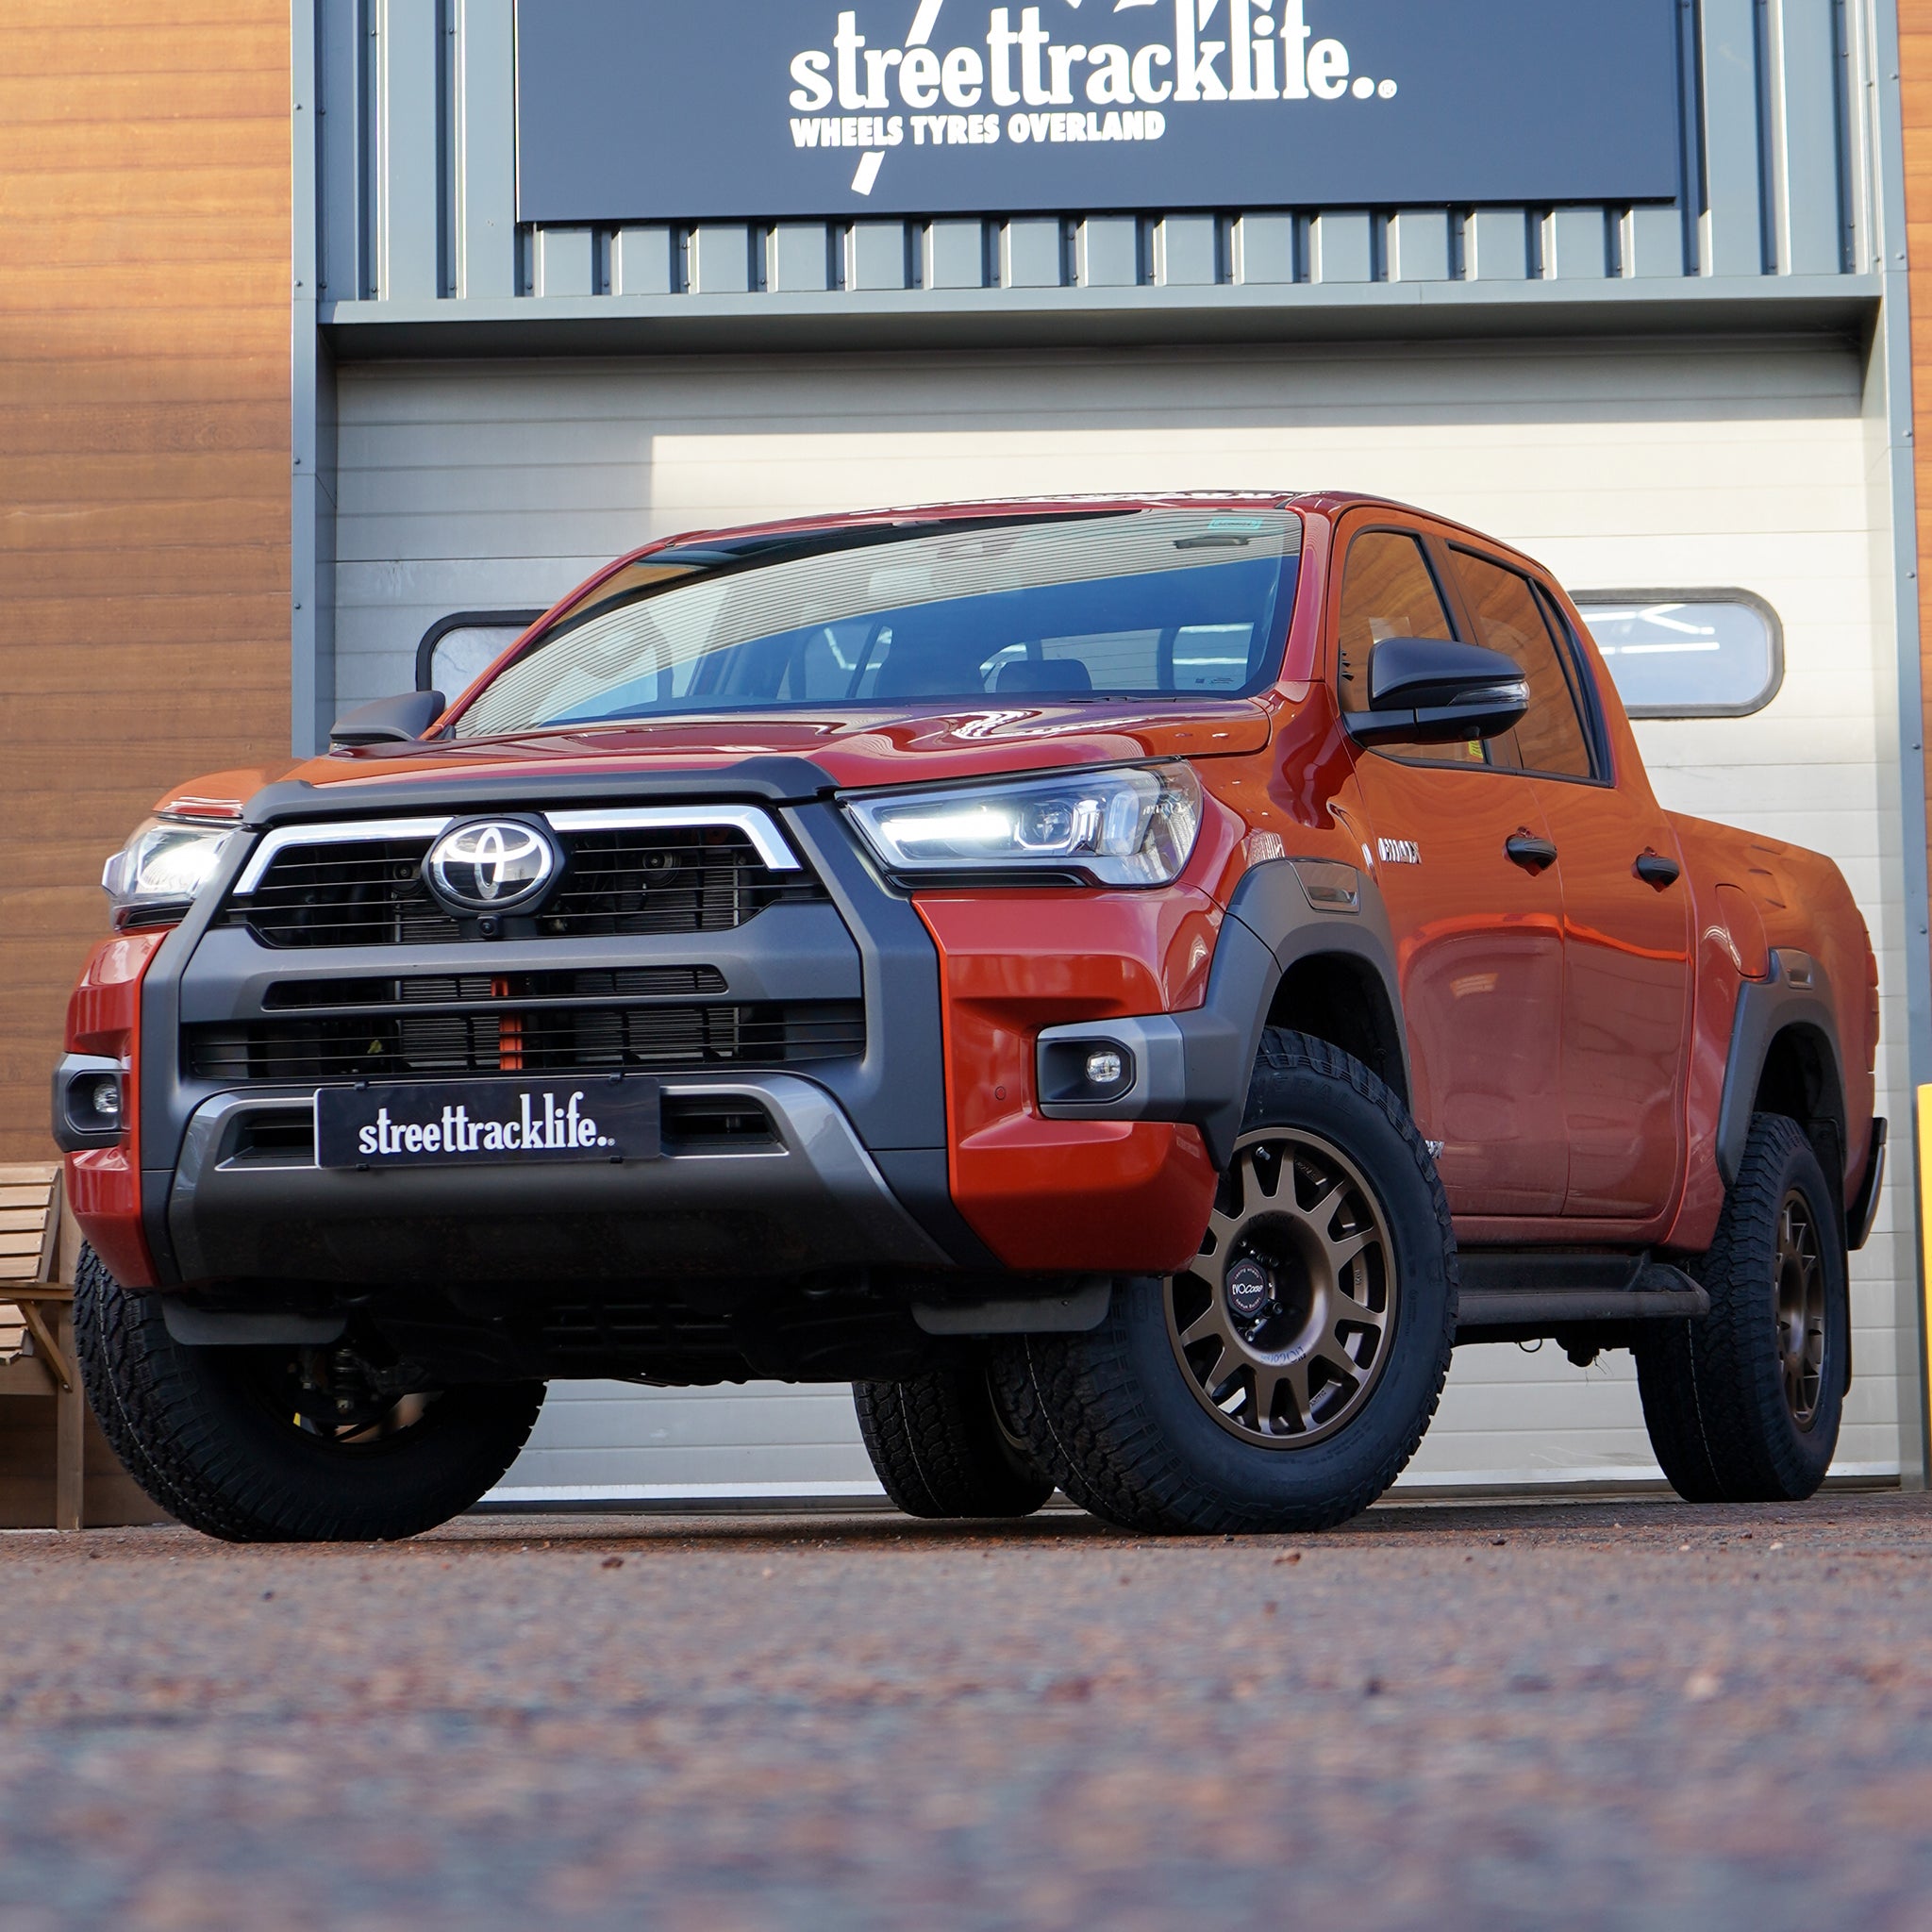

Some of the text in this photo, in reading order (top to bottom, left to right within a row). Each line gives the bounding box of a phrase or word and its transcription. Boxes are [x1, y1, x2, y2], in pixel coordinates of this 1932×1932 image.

[790, 110, 1167, 148] WHEELS TYRES OVERLAND
